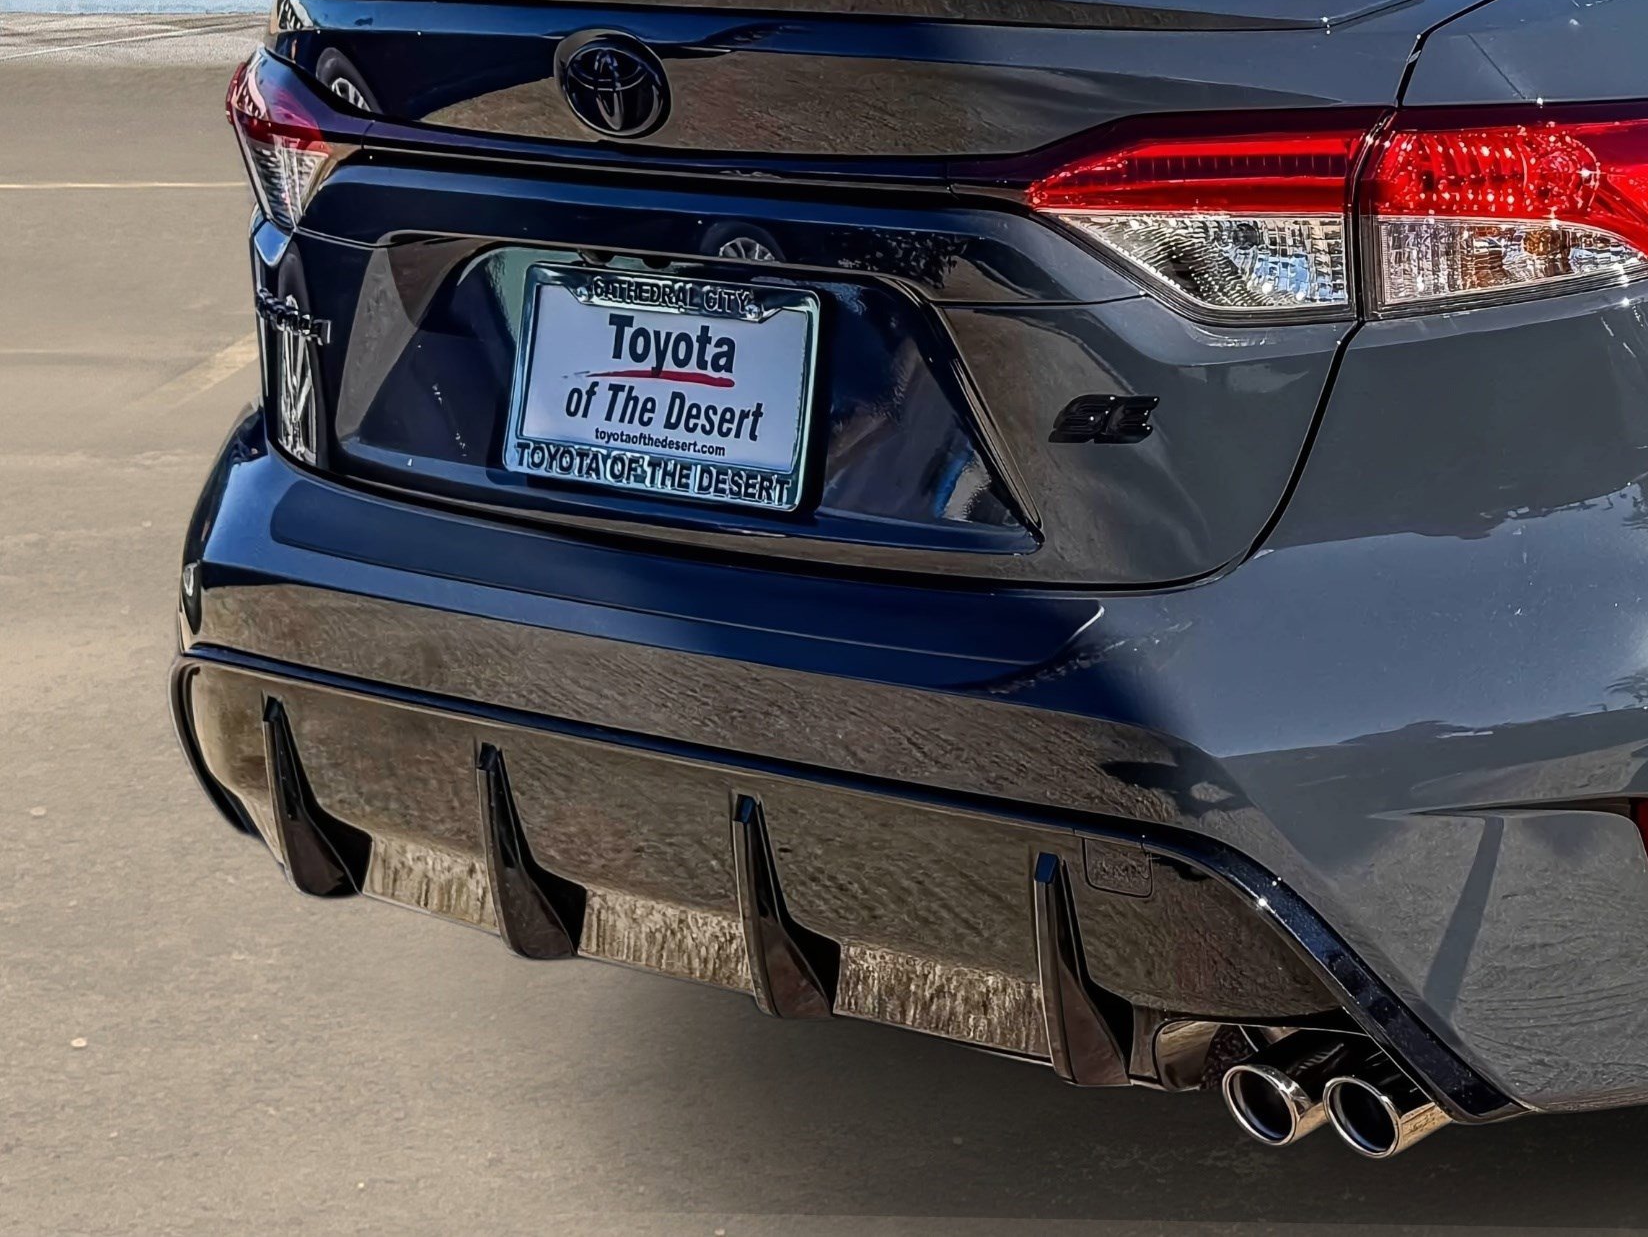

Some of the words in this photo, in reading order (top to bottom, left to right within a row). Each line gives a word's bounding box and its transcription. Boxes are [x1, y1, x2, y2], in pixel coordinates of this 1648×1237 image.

[592, 276, 700, 308] CATHEDRAL
[702, 284, 752, 314] CITY
[608, 313, 737, 378] Toyota
[565, 381, 600, 418] of
[604, 382, 657, 427] The
[663, 390, 764, 442] Desert
[1048, 394, 1161, 444] SE
[594, 427, 726, 458] toyotaofthedesert.com
[514, 442, 602, 481] TOYOTA
[607, 451, 644, 484] OF
[647, 458, 693, 492] THE
[697, 464, 793, 506] DESERT
